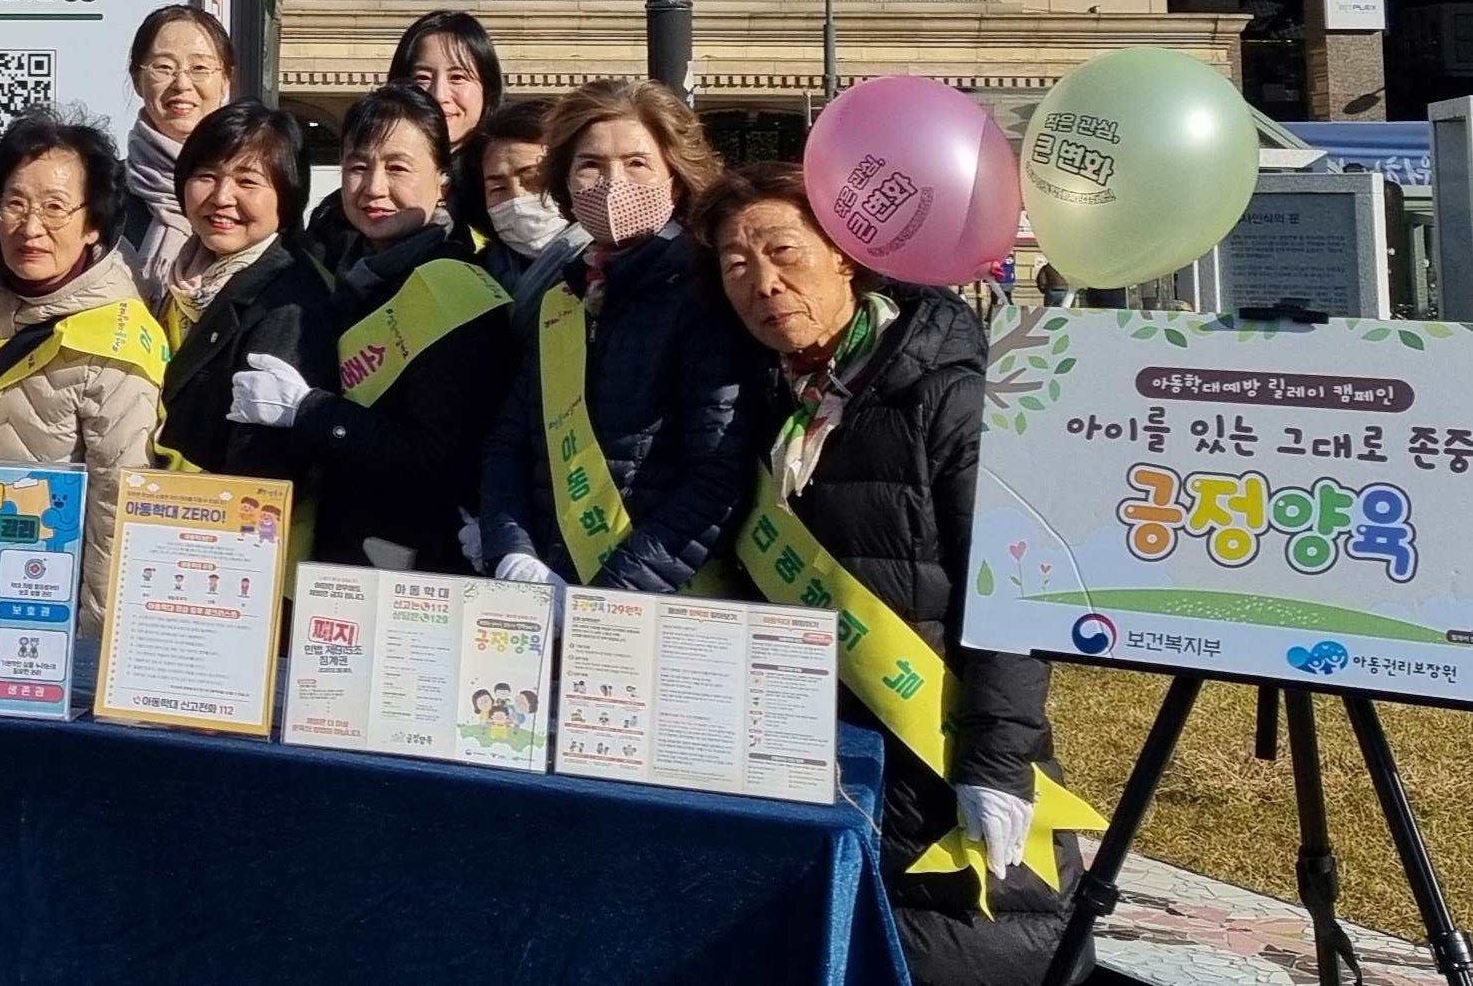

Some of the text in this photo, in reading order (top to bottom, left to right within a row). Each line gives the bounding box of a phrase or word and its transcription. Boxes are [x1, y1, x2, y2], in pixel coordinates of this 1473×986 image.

[1044, 112, 1077, 132] 작은
[1032, 132, 1056, 165] 큰
[1056, 138, 1115, 187] 변화
[834, 185, 859, 219] 작은
[862, 171, 918, 223] 변화
[847, 211, 878, 244] 큰
[1152, 373, 1395, 407] 아동학대예방 릴레이 캠페인
[1066, 406, 1473, 474] 아이를 있는 그대로 존중
[126, 501, 226, 523] 아동학대 ZERO!
[1119, 463, 1418, 582] 긍정양육
[1127, 629, 1222, 659] 보건복지부
[881, 659, 925, 701] 날
[1353, 655, 1458, 684] 아동권리보장원
[142, 696, 233, 715] 아동학대 신고전화 112
